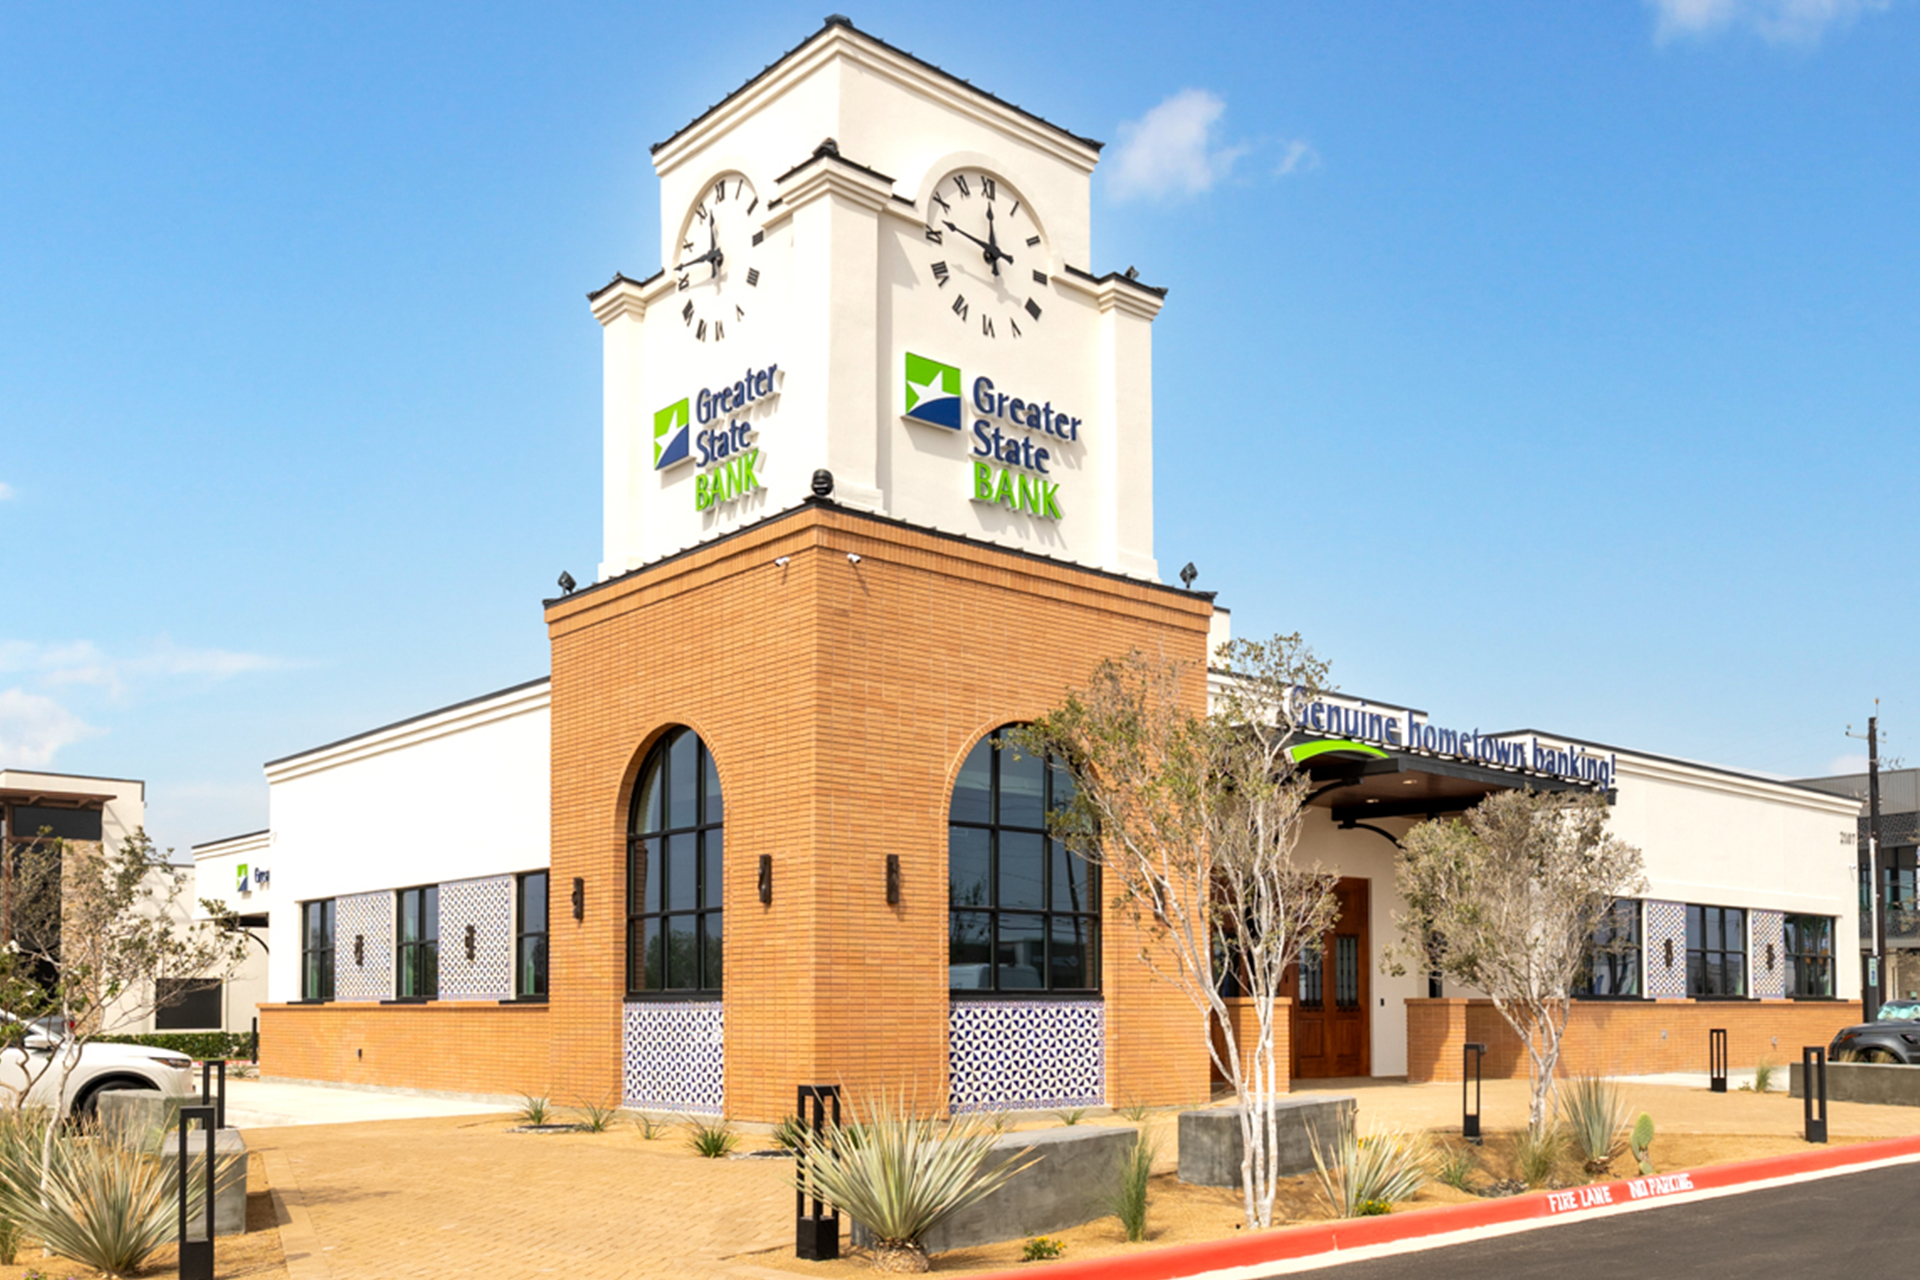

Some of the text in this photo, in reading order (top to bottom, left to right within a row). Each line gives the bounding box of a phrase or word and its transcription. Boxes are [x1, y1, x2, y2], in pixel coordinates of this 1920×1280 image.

[933, 191, 951, 214] X
[980, 175, 995, 201] XII
[696, 363, 777, 424] Greater
[973, 376, 1082, 441] Greater
[696, 419, 751, 467] State
[973, 419, 1050, 474] State
[696, 448, 759, 511] BANK
[974, 461, 1062, 520] BANK
[1290, 685, 1616, 793] Genuine hometown banking!
[1547, 1173, 1694, 1212] FIRE LANE NO PARKING
